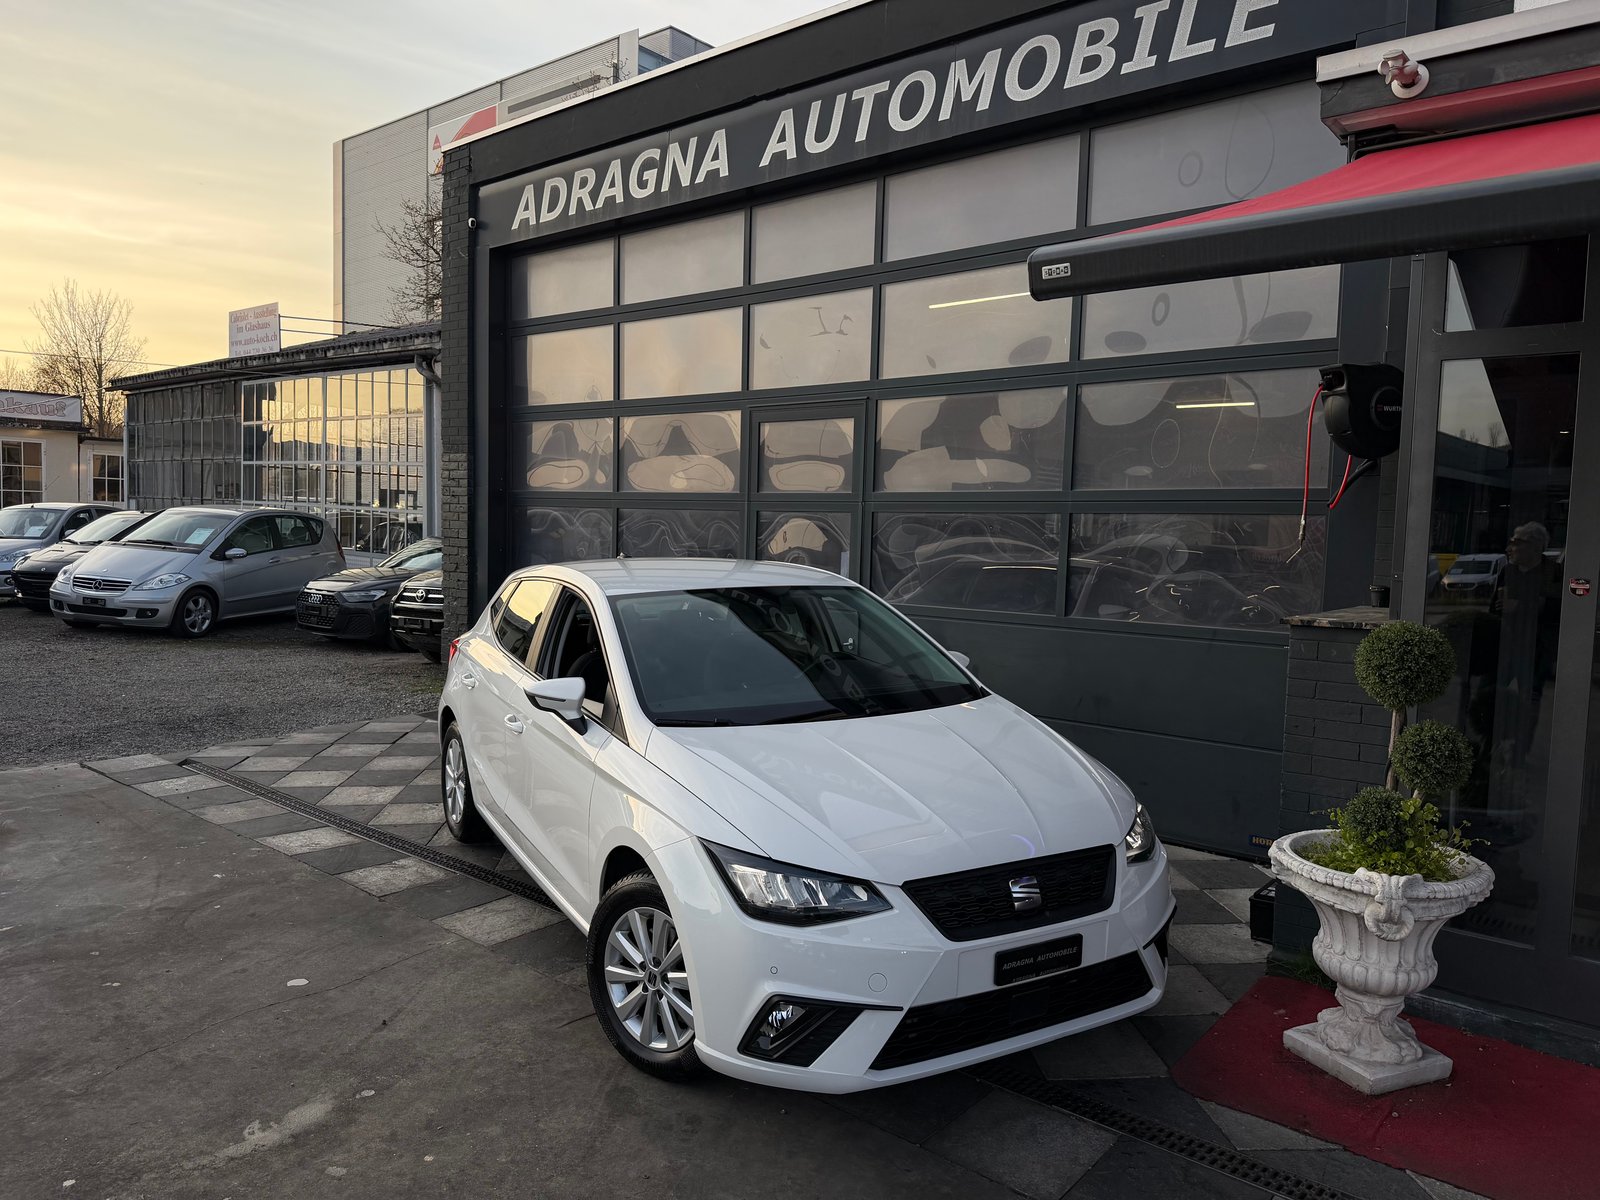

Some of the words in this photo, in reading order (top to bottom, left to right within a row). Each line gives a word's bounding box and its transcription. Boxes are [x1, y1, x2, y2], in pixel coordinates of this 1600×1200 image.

[511, 128, 730, 230] ADRAGNA
[759, 0, 1280, 168] AUTOMOBILE
[245, 321, 271, 332] Glashaus
[231, 332, 278, 346] www.auto-koch.ch
[1002, 957, 1034, 970] ADRAGNA
[1036, 946, 1078, 962] AUTOMOBILE
